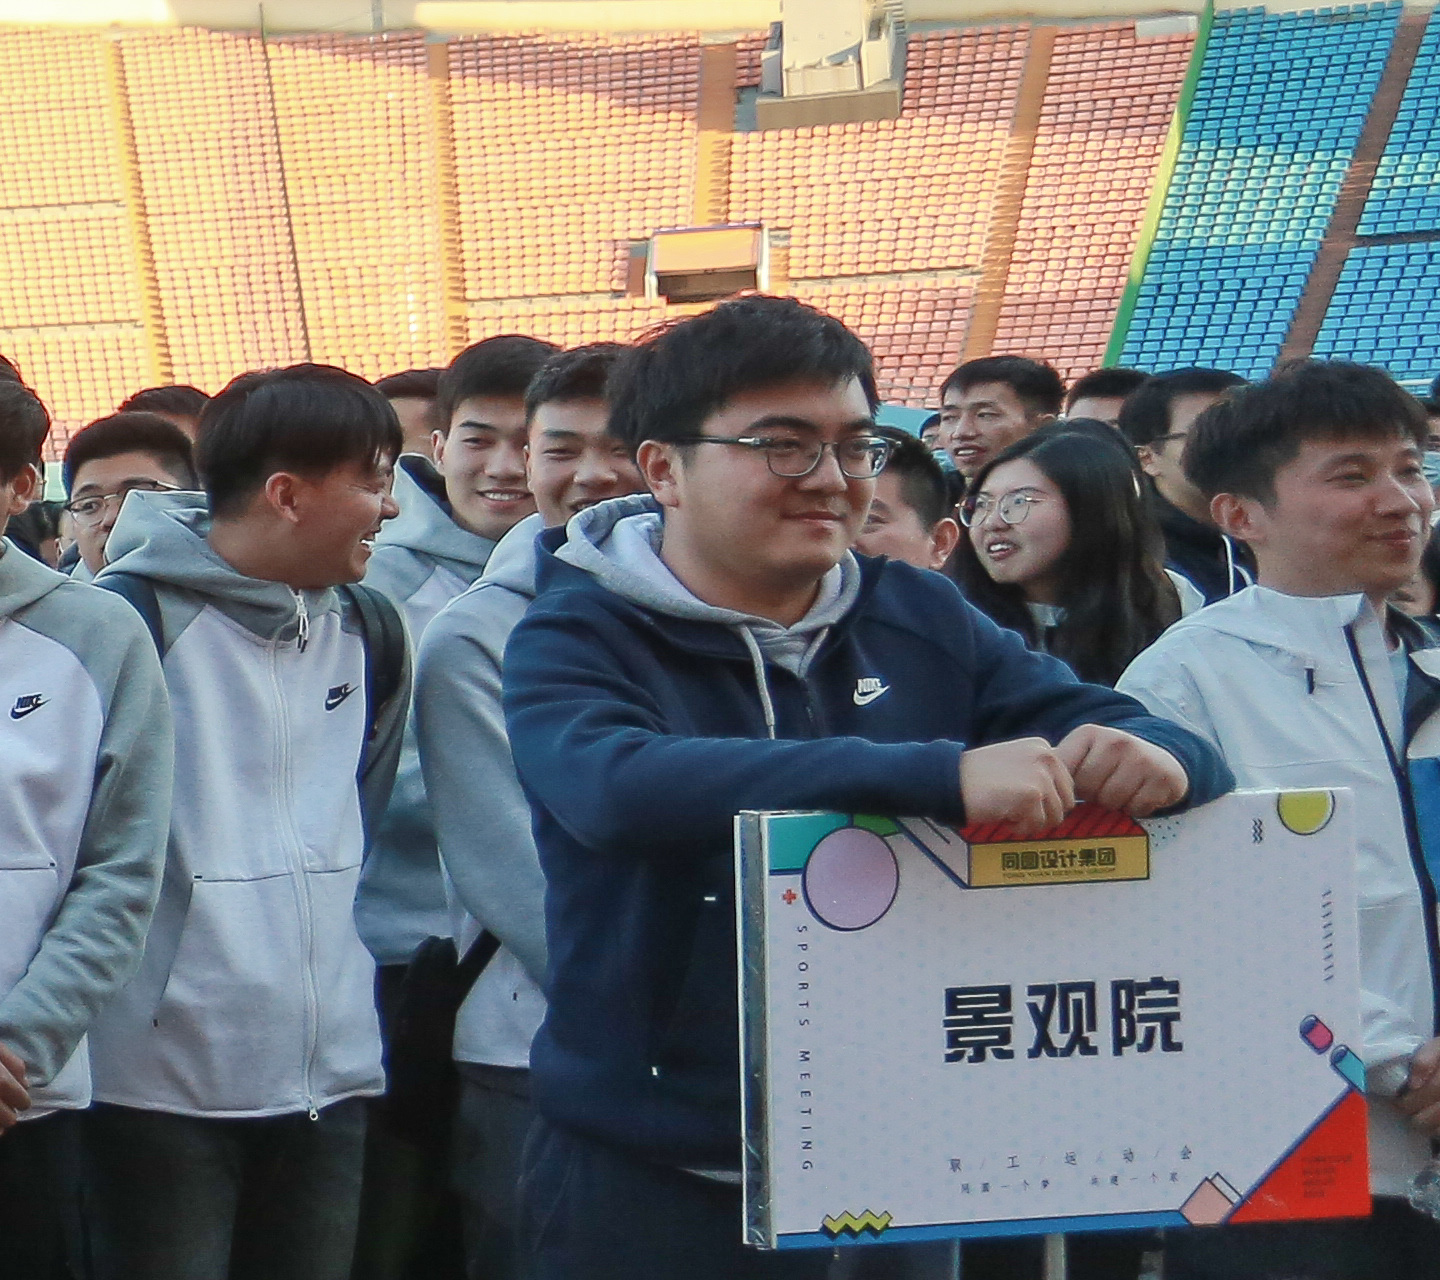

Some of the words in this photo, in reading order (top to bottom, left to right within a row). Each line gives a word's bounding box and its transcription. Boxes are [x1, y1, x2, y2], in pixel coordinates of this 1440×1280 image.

[797, 925, 810, 1027] SPORTS
[943, 977, 1183, 1063] 景观院
[799, 1050, 813, 1171] MEETING
